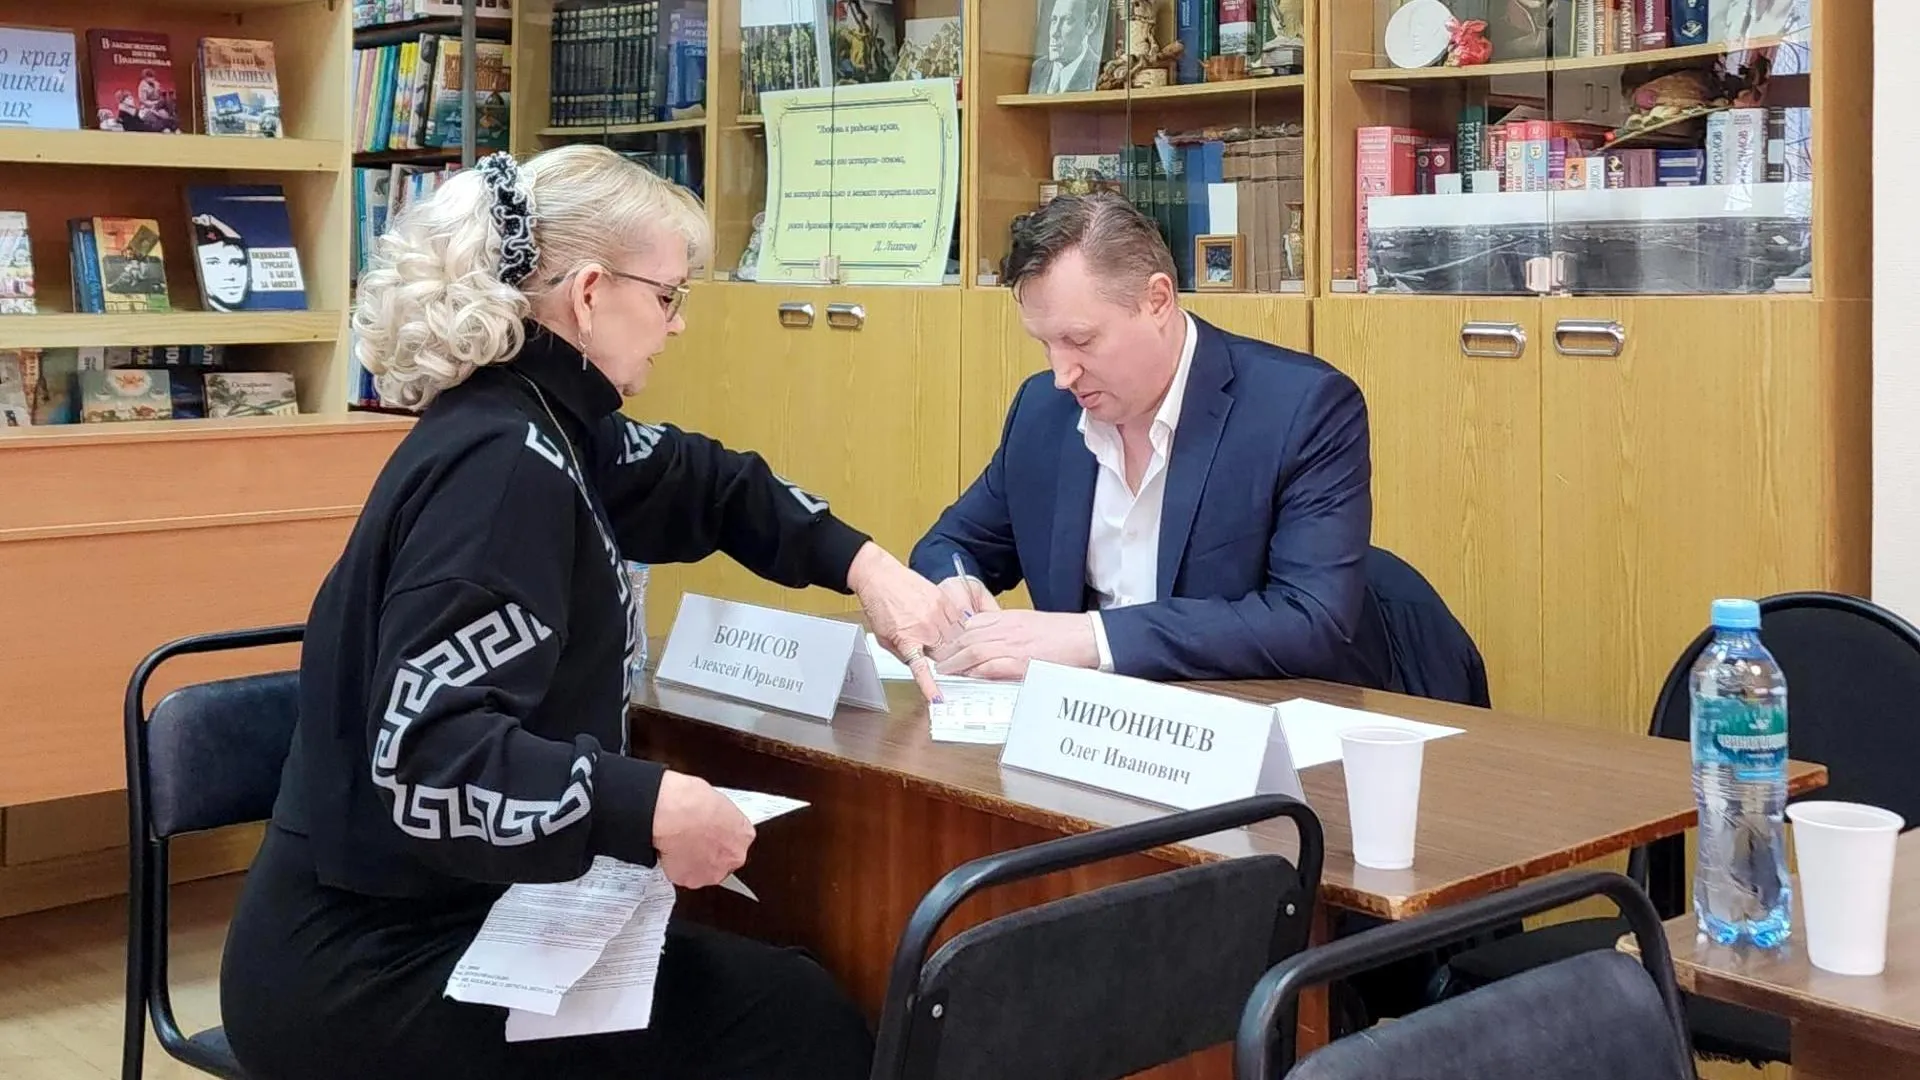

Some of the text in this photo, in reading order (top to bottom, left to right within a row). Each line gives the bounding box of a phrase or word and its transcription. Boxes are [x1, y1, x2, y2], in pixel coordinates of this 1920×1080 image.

[20, 49, 71, 74] края
[101, 37, 110, 49] В
[714, 625, 800, 659] БОРИСОВ
[689, 653, 805, 693] Алексей Юрьевич
[1057, 696, 1216, 753] МИРОНИЧЕВ
[1059, 736, 1191, 785] Олег Иванович
